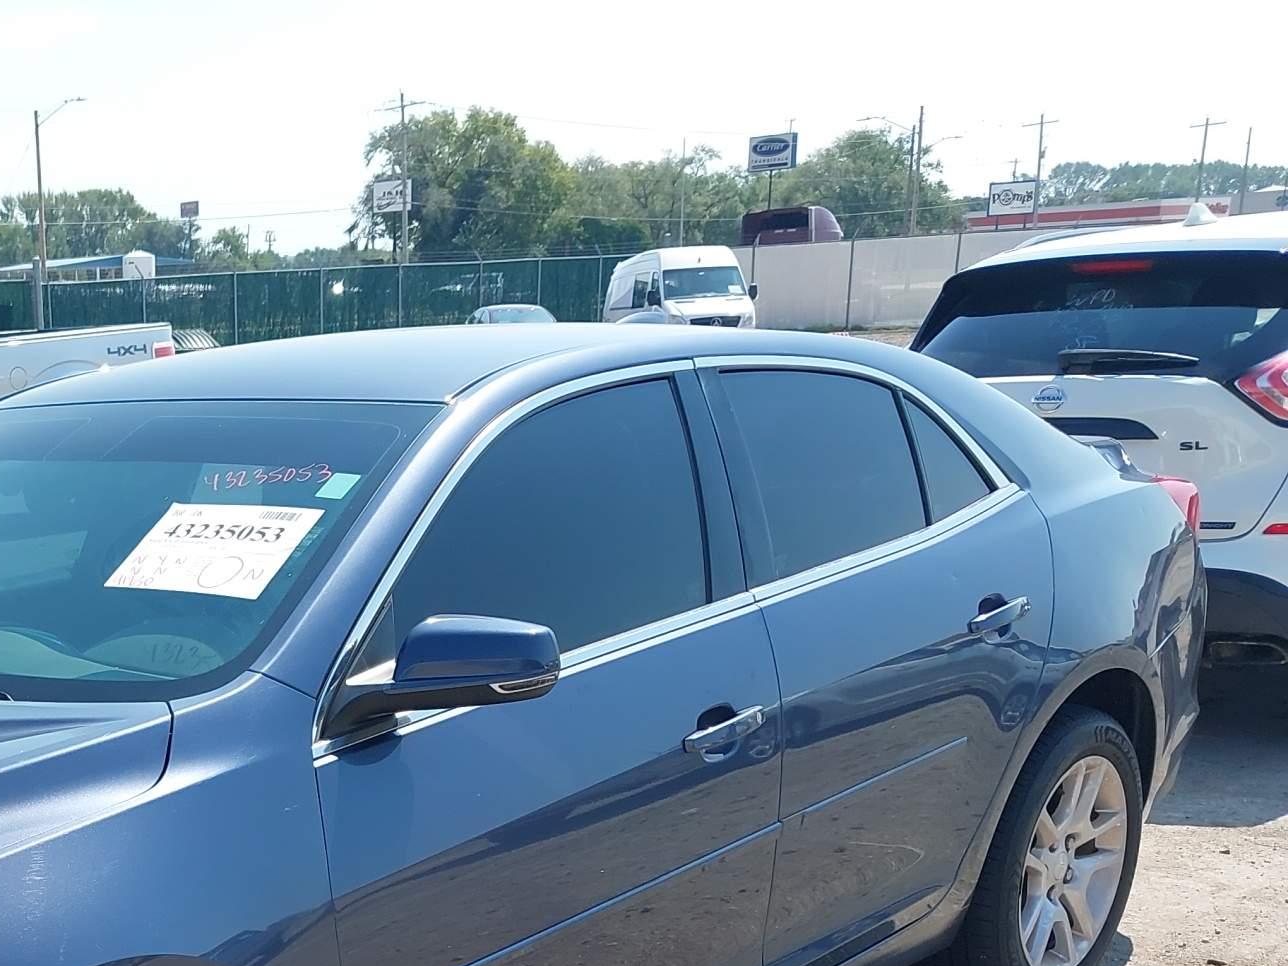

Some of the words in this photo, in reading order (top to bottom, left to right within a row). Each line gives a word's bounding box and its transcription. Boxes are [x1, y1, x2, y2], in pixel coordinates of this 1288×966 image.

[756, 143, 784, 153] Carrier
[1179, 440, 1209, 452] SL
[203, 463, 333, 491] 43235053
[163, 522, 286, 544] 43235053
